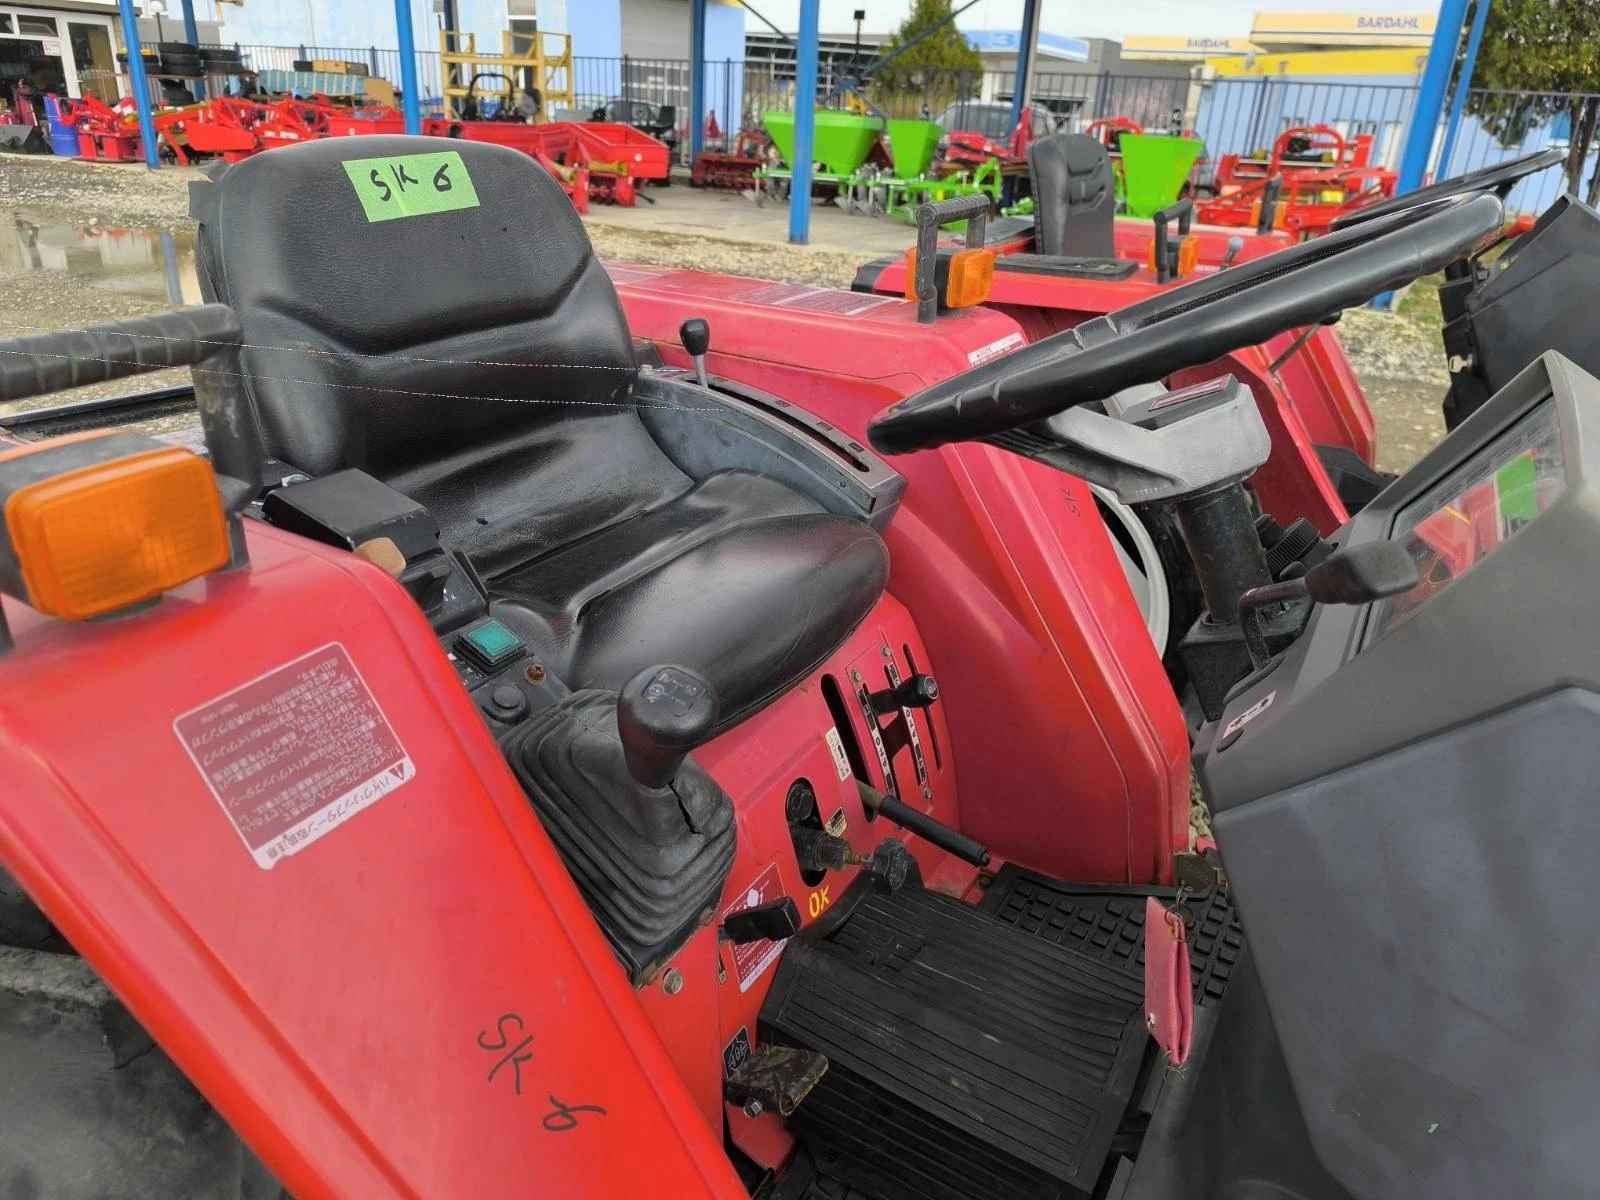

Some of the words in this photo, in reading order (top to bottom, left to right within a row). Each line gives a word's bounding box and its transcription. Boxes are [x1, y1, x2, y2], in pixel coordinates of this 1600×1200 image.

[1356, 16, 1419, 29] BARDAHL
[370, 163, 418, 202] SK
[433, 163, 452, 192] 6
[808, 885, 830, 918] OK
[477, 1013, 533, 1096] SK
